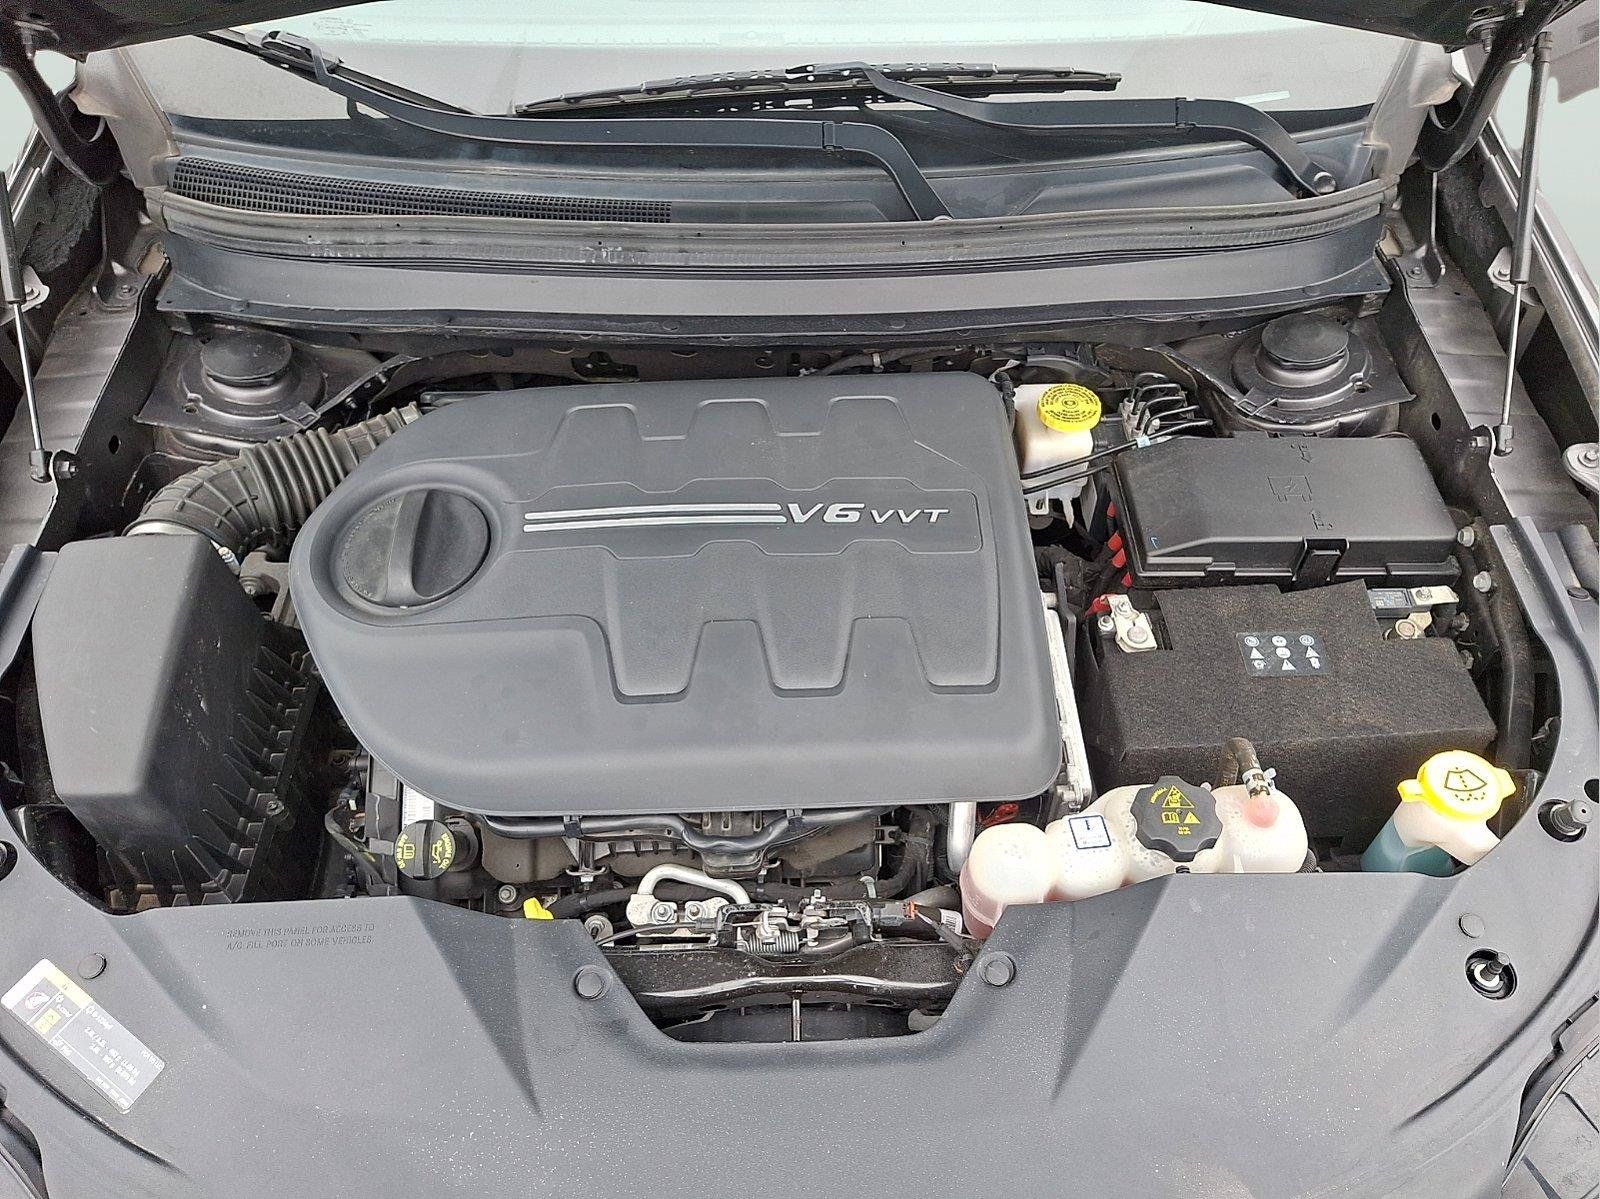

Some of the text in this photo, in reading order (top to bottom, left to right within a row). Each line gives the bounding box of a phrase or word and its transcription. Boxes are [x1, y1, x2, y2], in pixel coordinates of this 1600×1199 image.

[787, 503, 949, 524] V6 VVT
[226, 923, 375, 939] REMOVE THIS PANEL FOR ACCESS TO
[226, 935, 372, 950] A/C FILL PORT ON SOME VEHICLES
